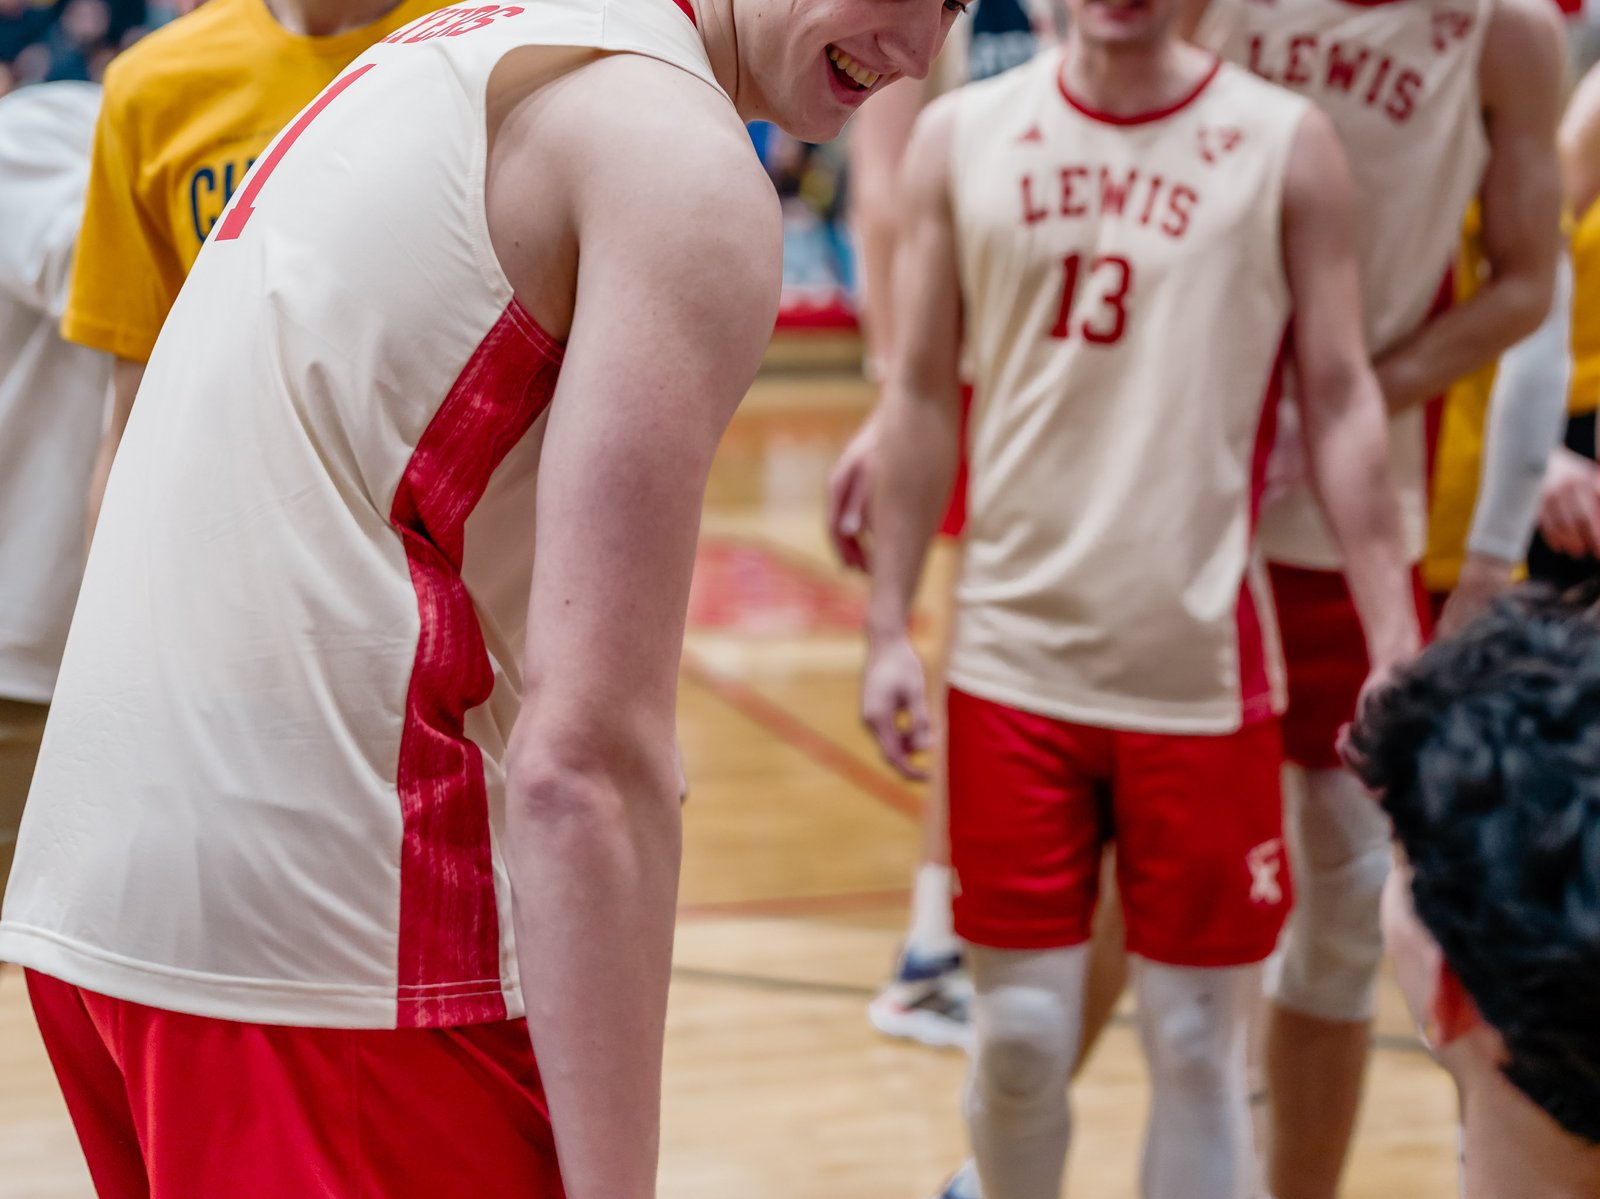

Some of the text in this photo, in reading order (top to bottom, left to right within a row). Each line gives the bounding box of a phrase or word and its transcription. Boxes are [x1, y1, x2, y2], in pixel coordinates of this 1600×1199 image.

[1248, 34, 1424, 122] LEWIS
[1020, 165, 1199, 240] LEWIS
[1049, 253, 1131, 345] 13
